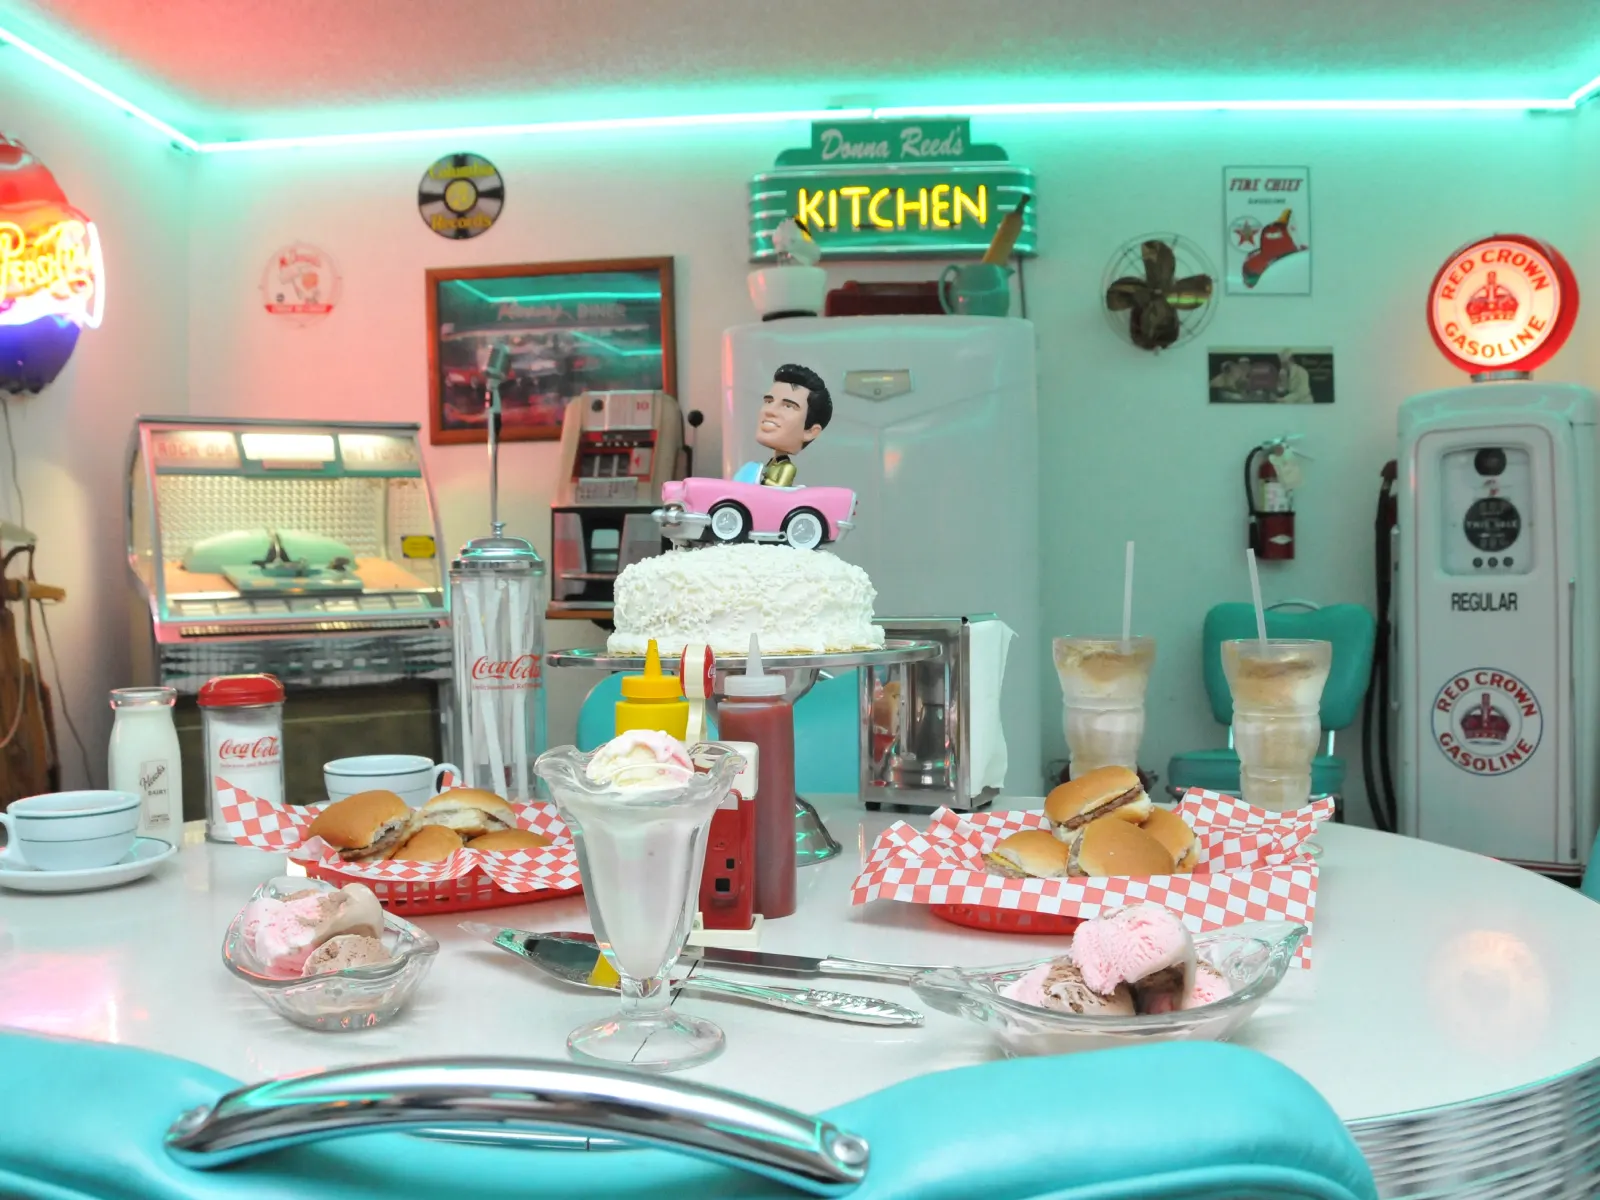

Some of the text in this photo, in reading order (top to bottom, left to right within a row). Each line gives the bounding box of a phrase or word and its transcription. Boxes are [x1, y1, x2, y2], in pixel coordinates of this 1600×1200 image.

[820, 126, 964, 161] Donna Reed's
[797, 183, 988, 229] KITCHEN
[1264, 177, 1304, 192] CHIEF
[1440, 247, 1551, 301] RED CROWN
[1444, 313, 1547, 360] GASOLINE
[1451, 592, 1519, 612] REGULAR
[1436, 670, 1538, 718] RED CROWN
[1438, 730, 1534, 774] GASOLINE
